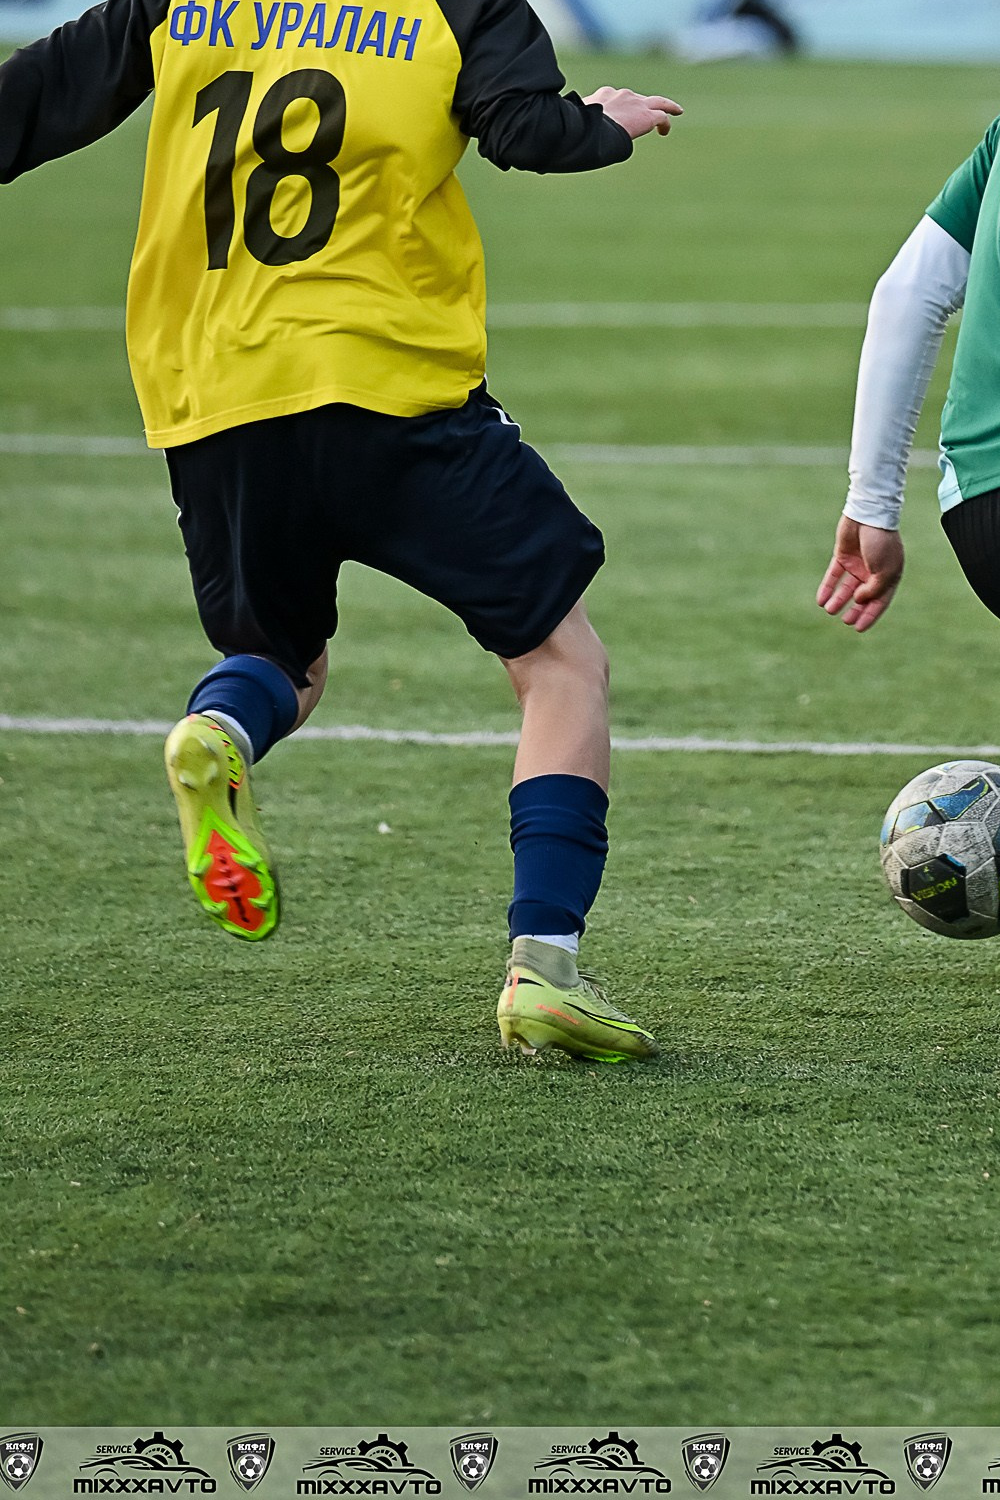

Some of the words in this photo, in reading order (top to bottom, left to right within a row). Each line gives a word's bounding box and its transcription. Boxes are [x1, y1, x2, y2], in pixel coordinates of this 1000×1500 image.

[169, 0, 241, 48] ФК
[250, 1, 422, 62] УРАЛАН
[192, 68, 347, 271] 18
